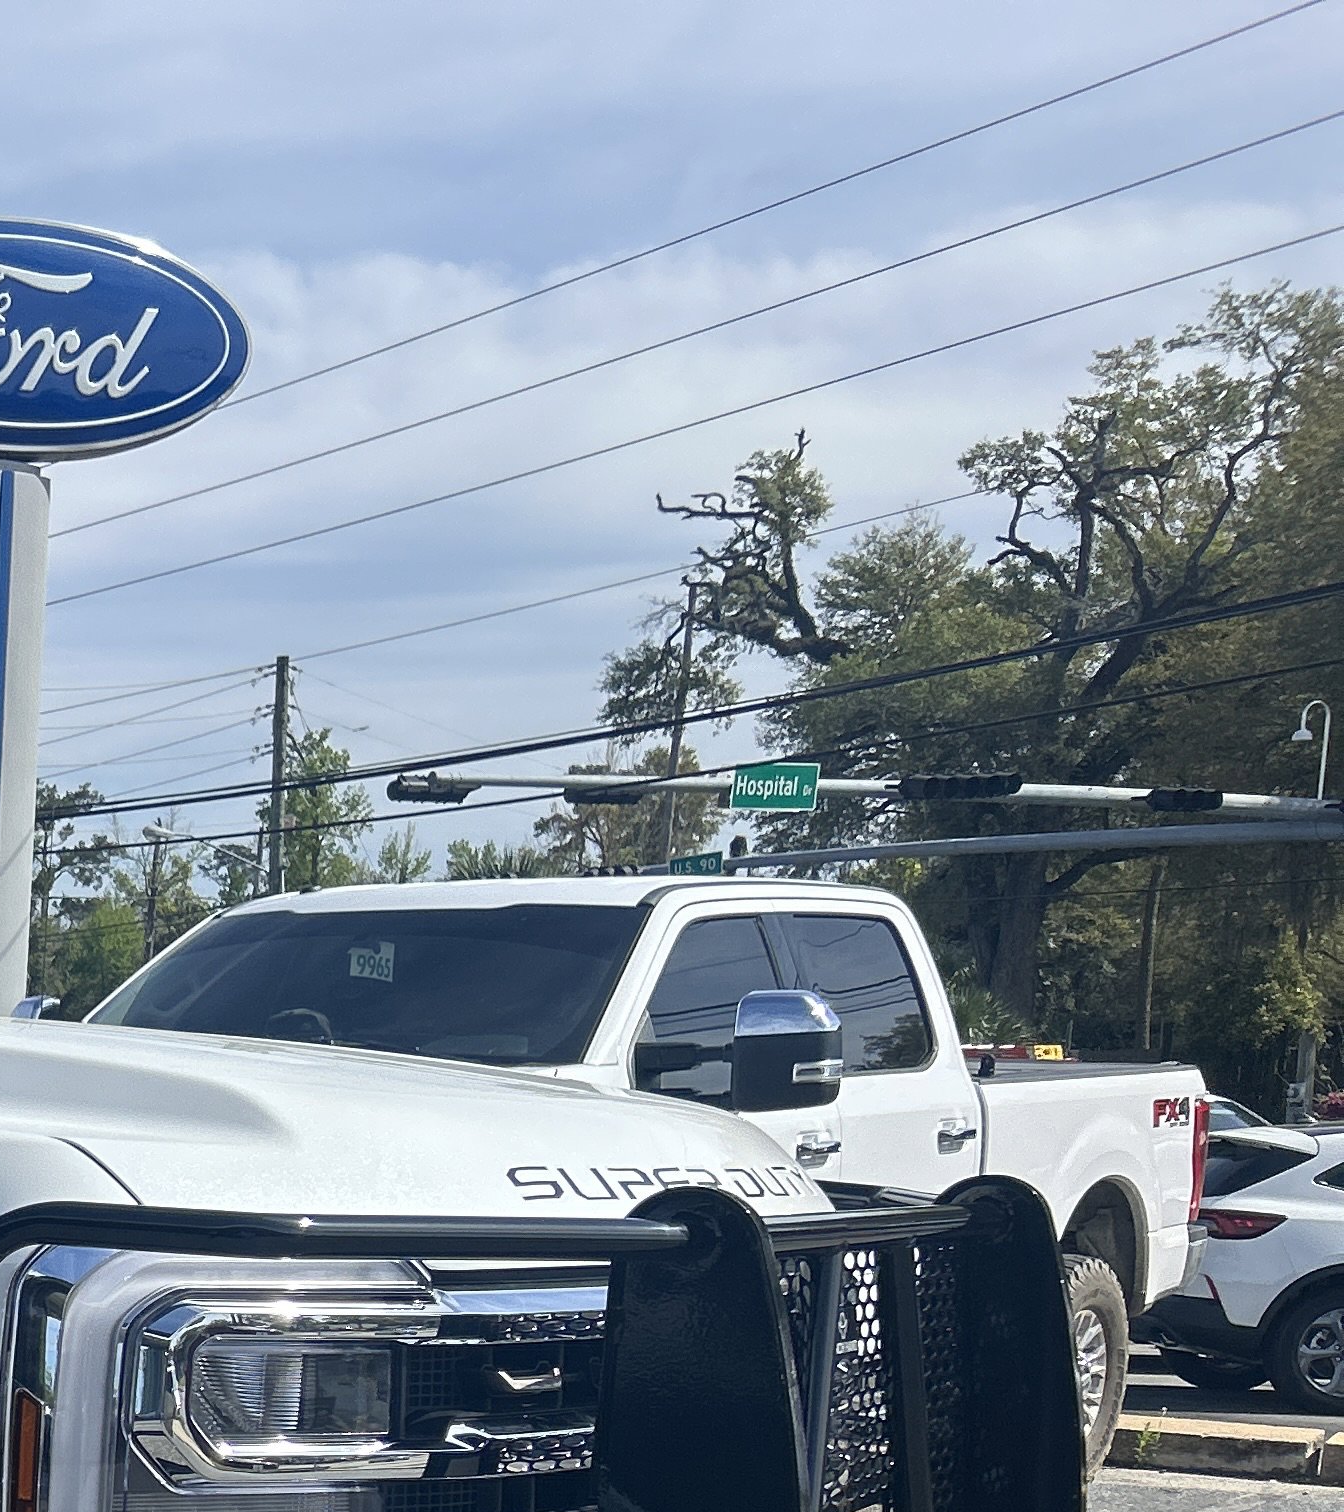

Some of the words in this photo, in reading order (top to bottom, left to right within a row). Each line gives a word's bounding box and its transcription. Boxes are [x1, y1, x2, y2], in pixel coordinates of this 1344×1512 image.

[736, 775, 799, 800] Hospital
[802, 786, 813, 796] Dr
[674, 861, 695, 875] U.S.
[699, 857, 716, 871] 90
[356, 954, 391, 978] 9965
[1152, 1097, 1191, 1128] FX4
